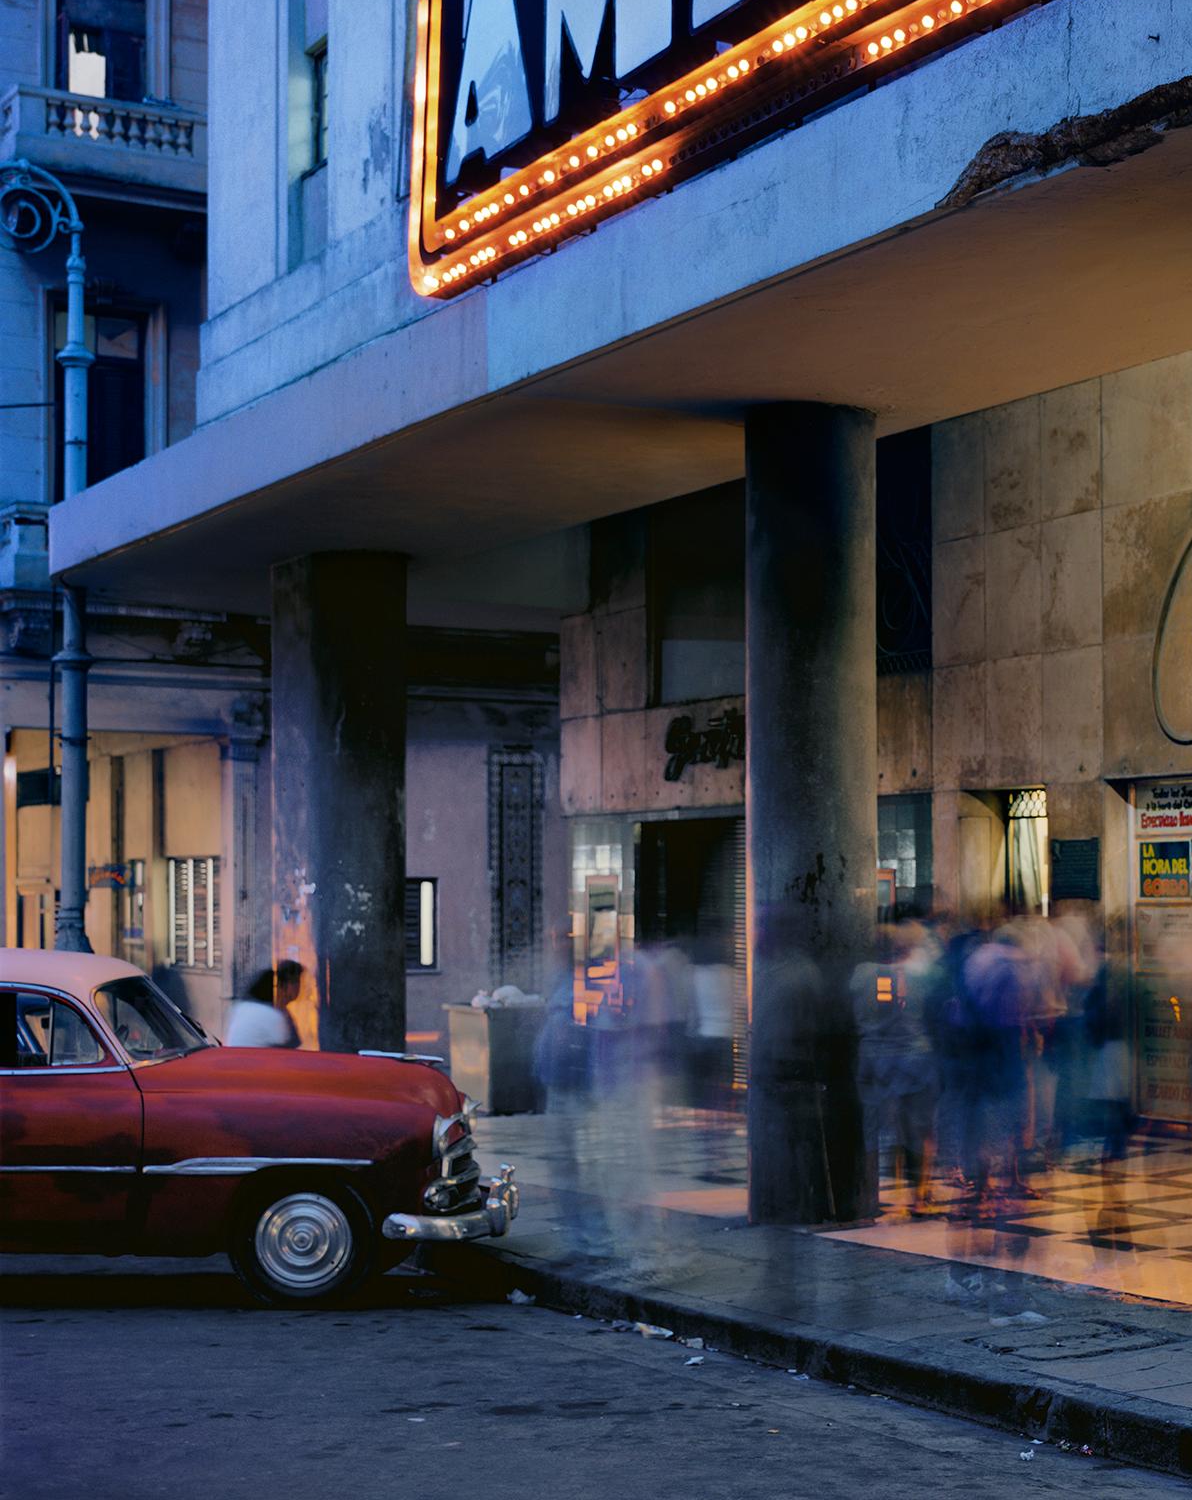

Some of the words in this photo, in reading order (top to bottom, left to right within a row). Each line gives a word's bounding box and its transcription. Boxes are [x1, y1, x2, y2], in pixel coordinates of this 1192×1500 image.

[1143, 843, 1155, 857] LA
[1143, 858, 1171, 875] HORA
[1171, 858, 1189, 874] DEL
[1143, 878, 1188, 896] GORDO
